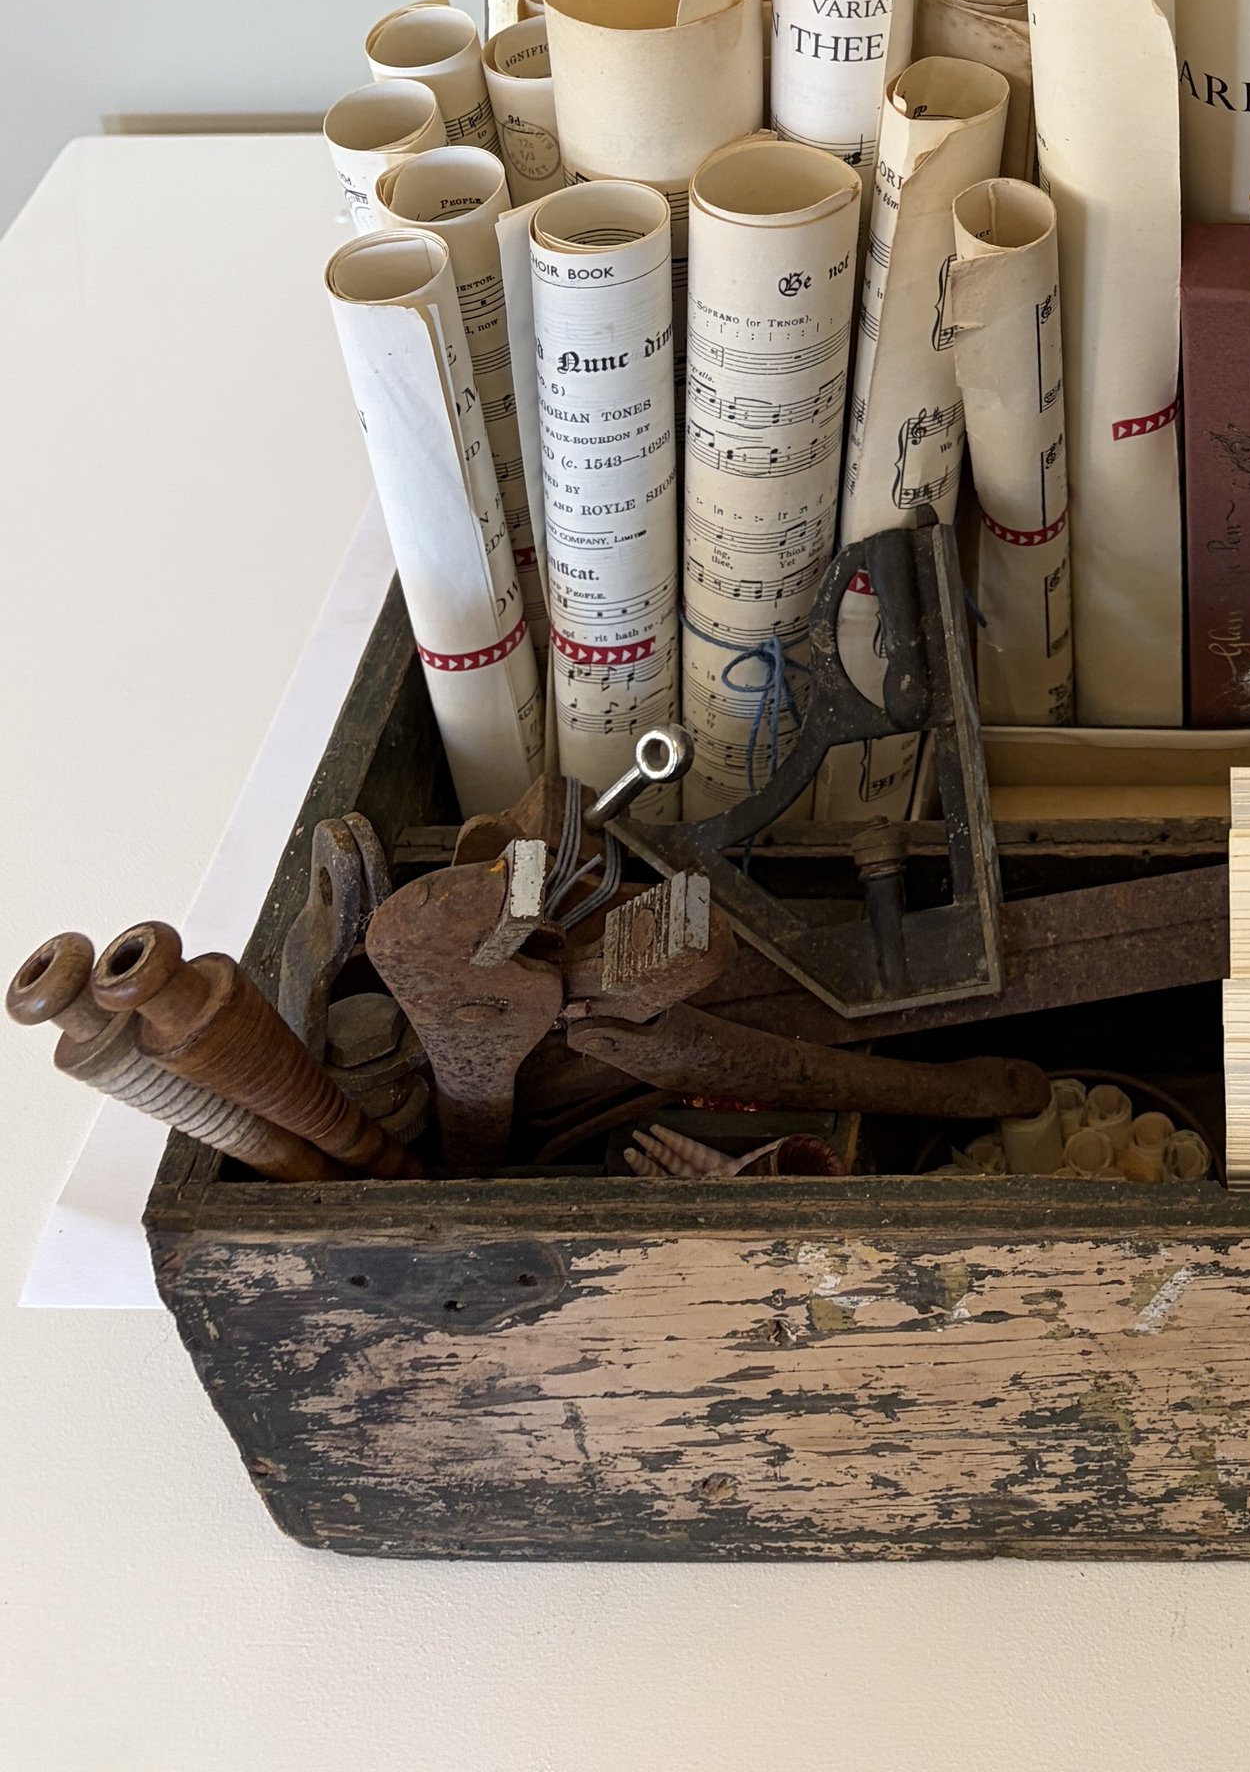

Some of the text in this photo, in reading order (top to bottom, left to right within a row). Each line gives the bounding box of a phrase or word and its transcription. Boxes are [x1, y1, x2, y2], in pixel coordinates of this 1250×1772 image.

[790, 24, 885, 62] THEE
[531, 254, 615, 280] HOIR BOOK
[778, 251, 851, 297] Be not
[477, 318, 499, 332] now
[745, 314, 761, 328] (or
[556, 350, 630, 375] Nunc
[601, 399, 652, 422] TONES
[636, 423, 651, 435] BY
[565, 484, 581, 495] BY
[553, 498, 636, 516] AND ROYLE
[560, 531, 610, 546] COMPANY,
[713, 544, 807, 561] ing, Think
[711, 555, 795, 570] thee, Yet
[595, 628, 639, 642] rit hath
